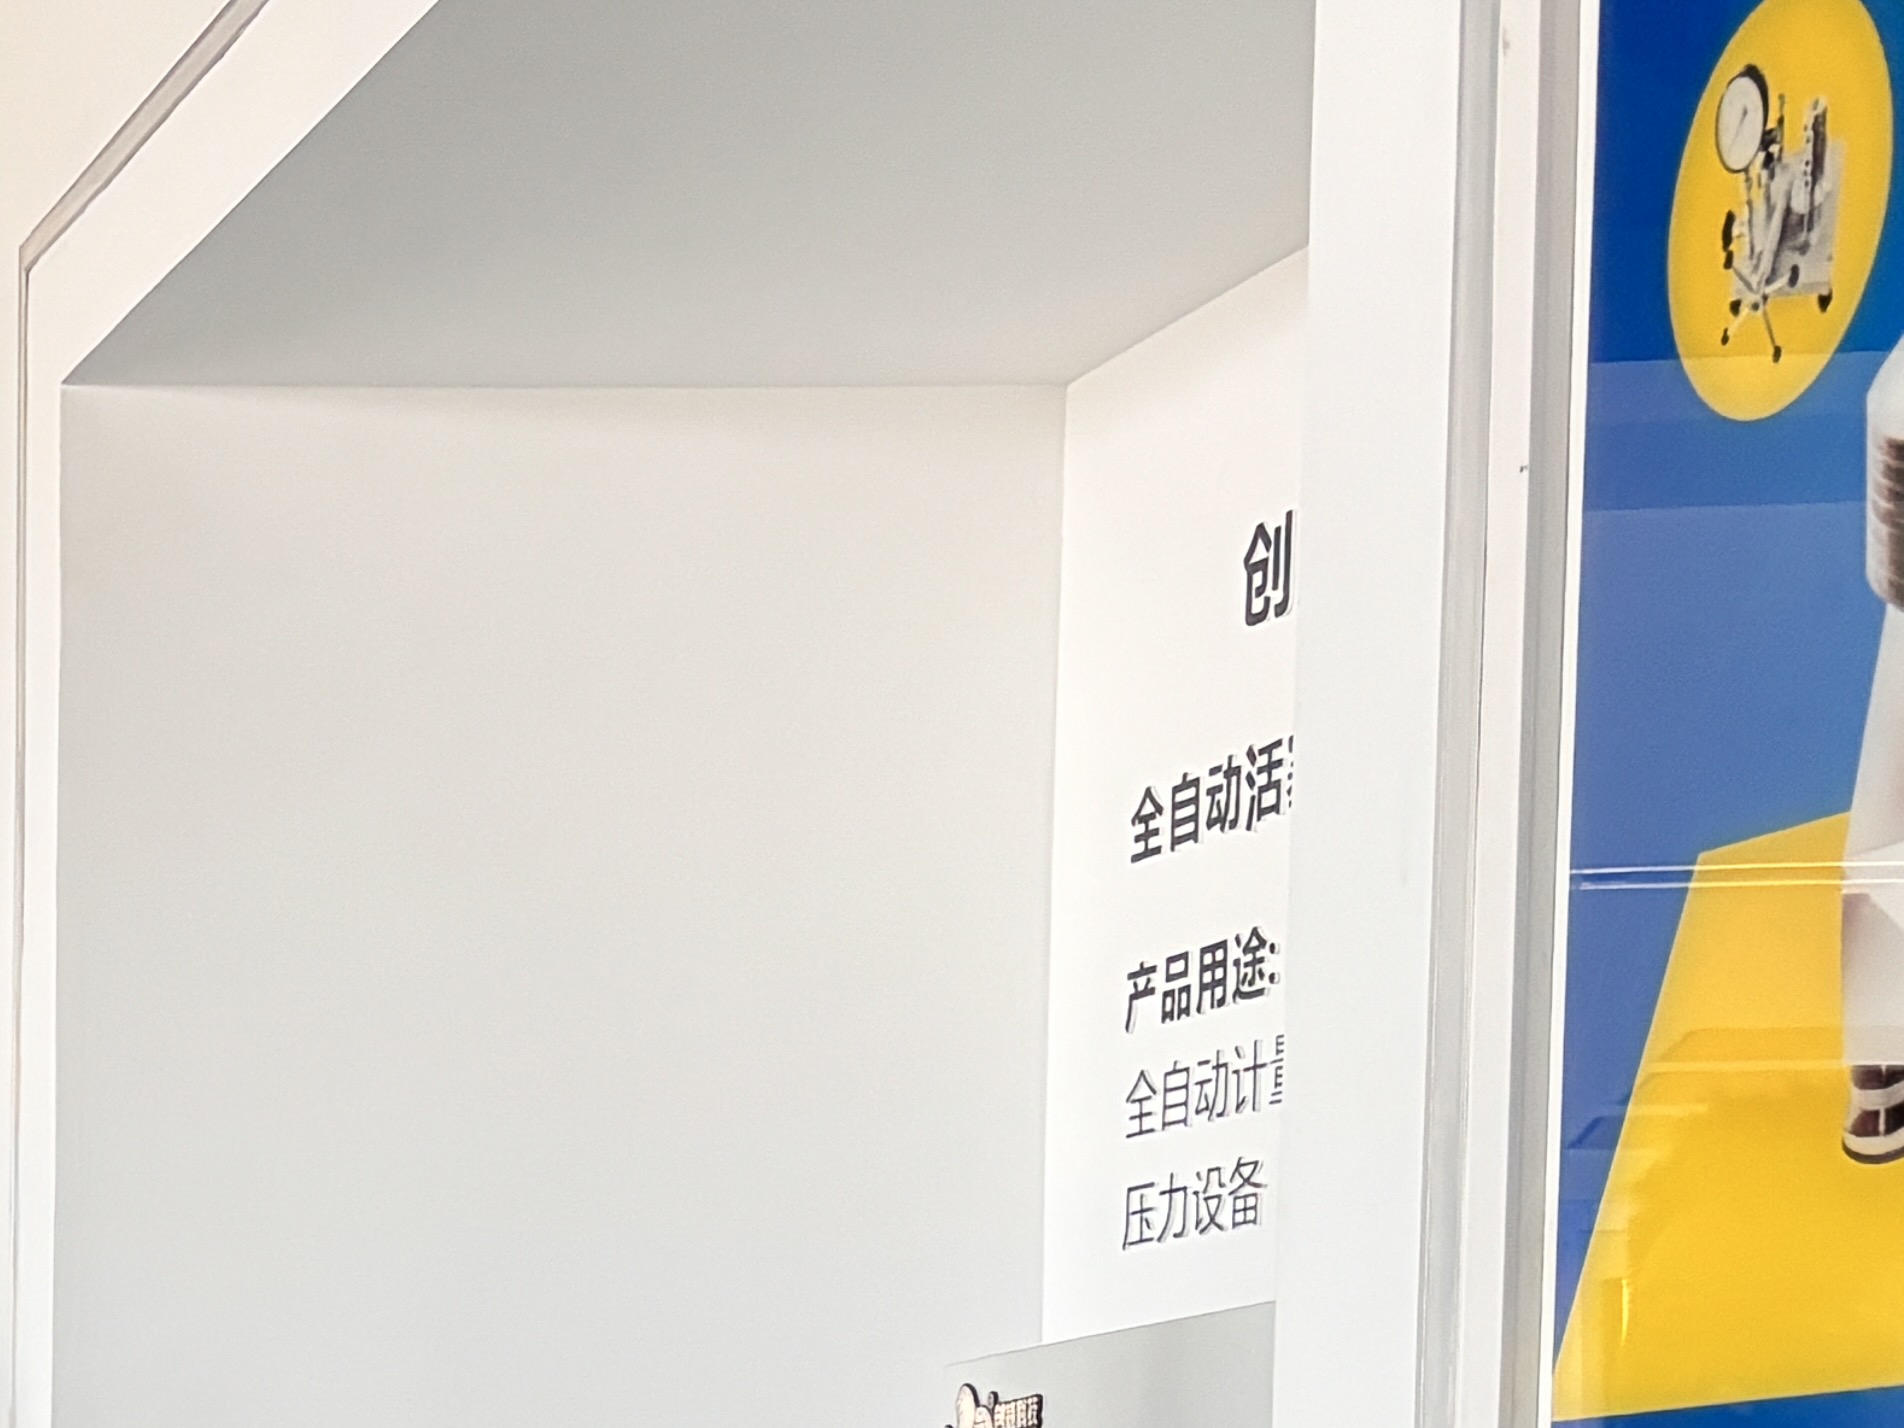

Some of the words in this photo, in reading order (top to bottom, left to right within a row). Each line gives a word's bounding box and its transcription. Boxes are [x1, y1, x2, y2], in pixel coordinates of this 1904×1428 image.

[1130, 734, 1294, 865] 全自动活
[1124, 926, 1282, 1033] 产品用途:
[1121, 1156, 1268, 1251] 压力设备
